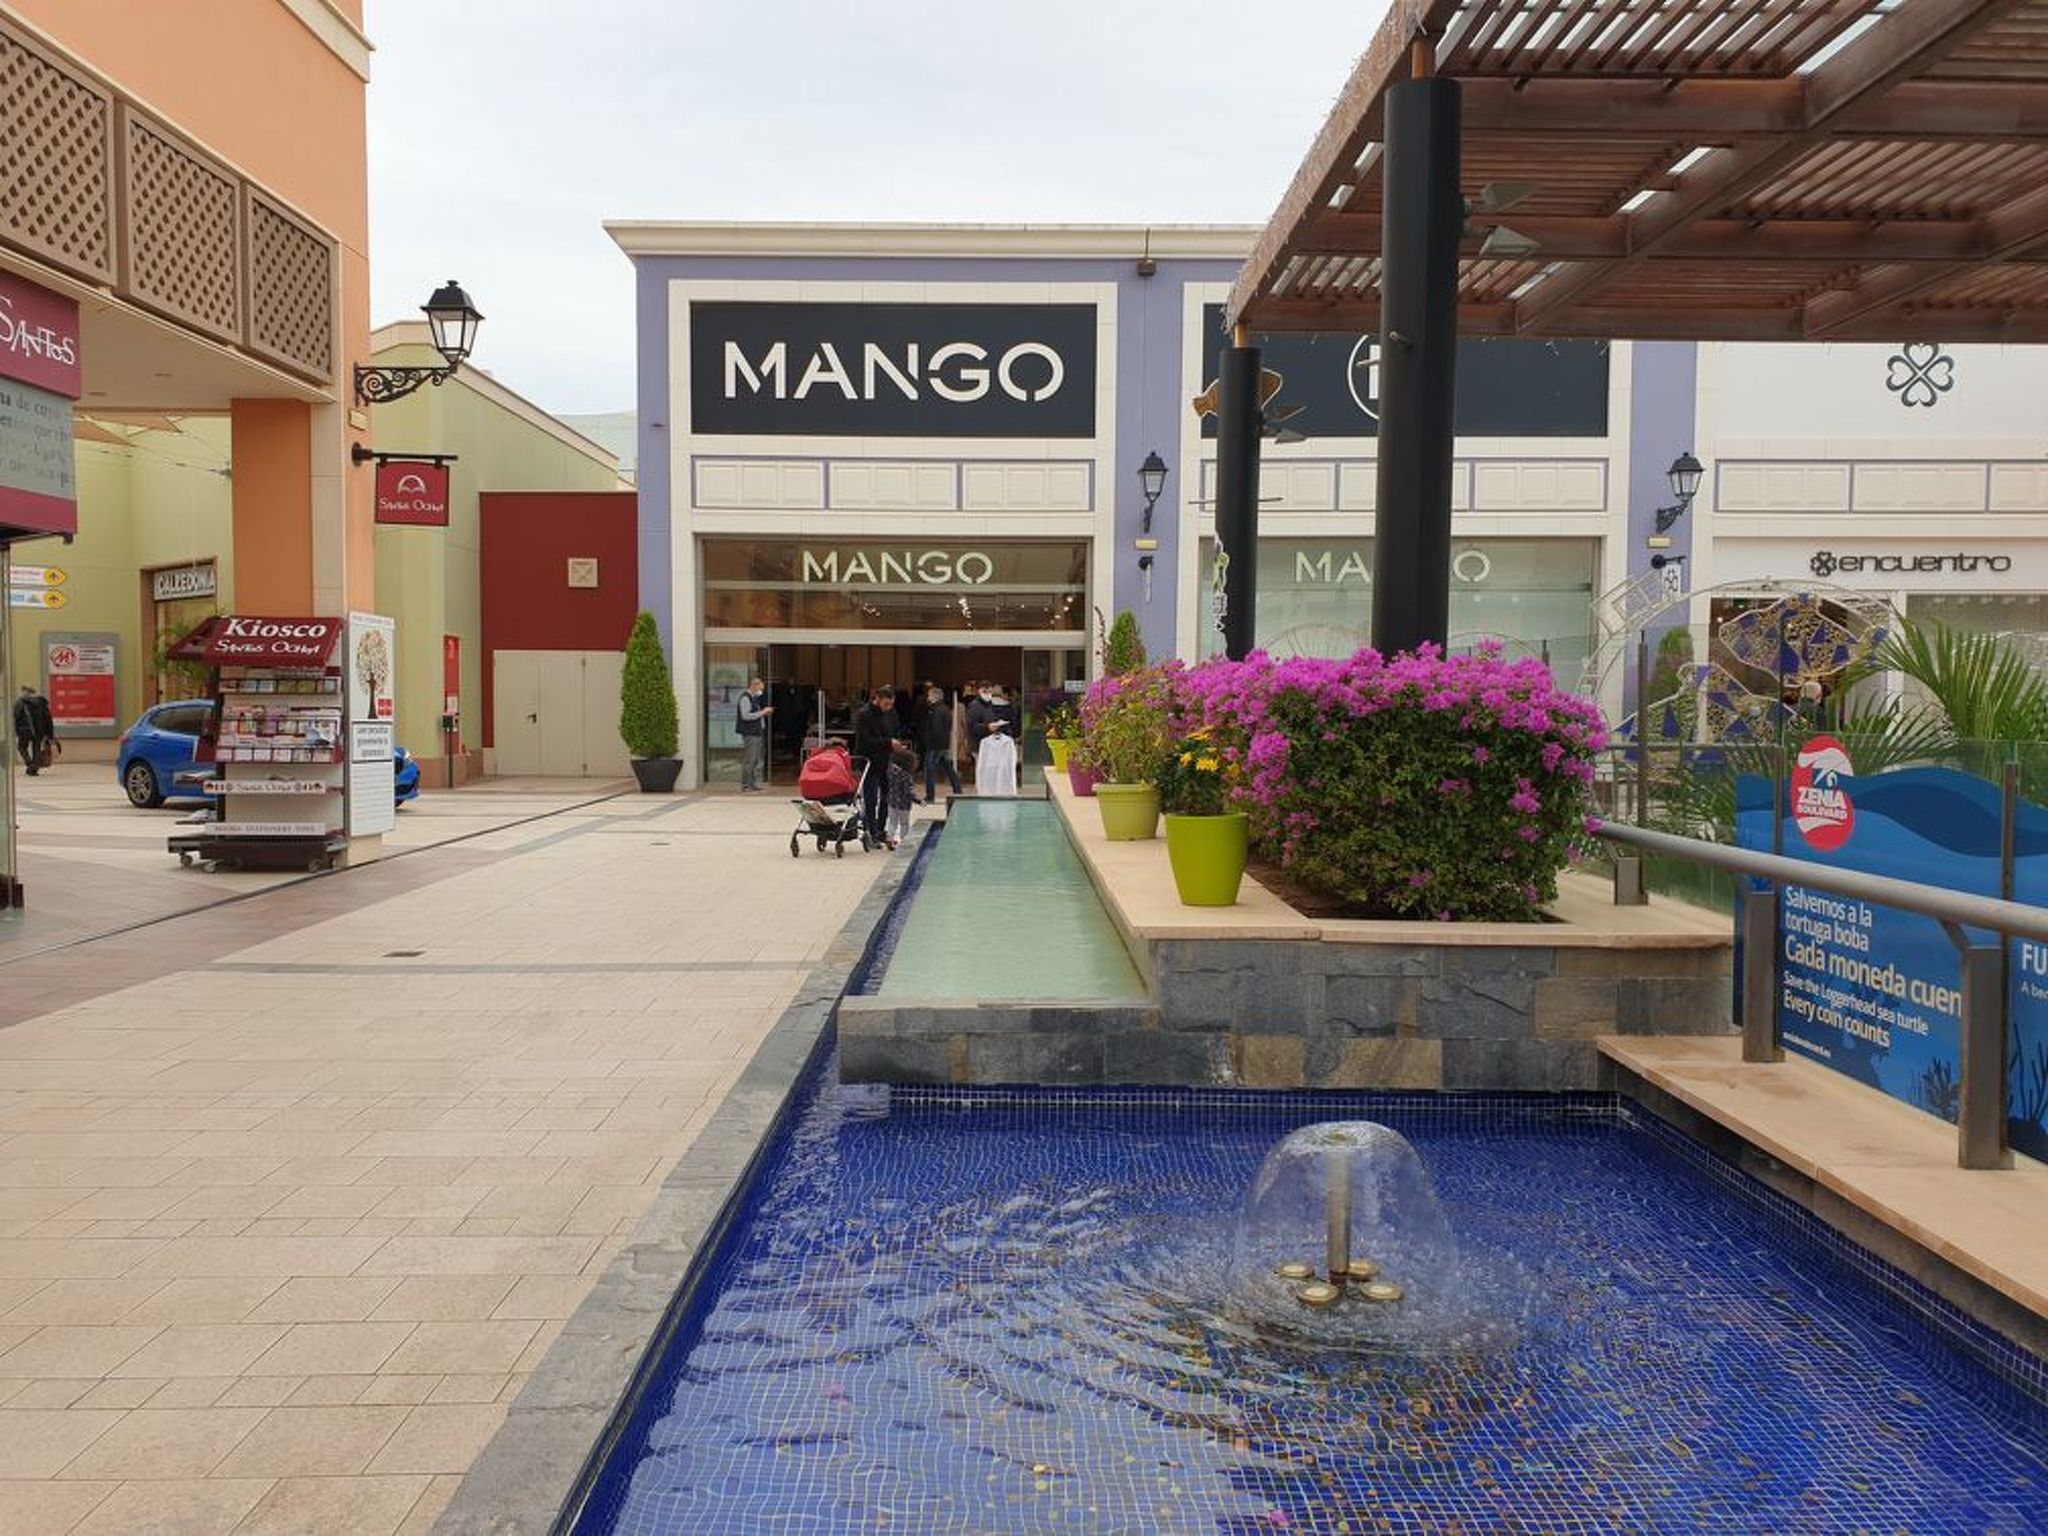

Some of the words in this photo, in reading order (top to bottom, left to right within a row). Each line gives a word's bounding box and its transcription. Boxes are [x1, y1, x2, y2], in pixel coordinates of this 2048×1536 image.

[724, 341, 1064, 402] MANGO
[803, 551, 993, 584] MANGO
[1296, 551, 1491, 583] MAO
[1839, 553, 2012, 572] encuentro
[224, 618, 327, 637] Kiosco
[1798, 787, 1847, 809] ZENIA
[1785, 886, 1845, 921] Salvemos
[1848, 909, 1857, 923] a
[1859, 902, 1872, 927] la
[1785, 911, 1831, 944] tortuga
[1834, 921, 1869, 952] boba
[1785, 935, 1825, 971] Cada
[1829, 952, 1906, 999] moneda
[1911, 979, 1962, 1017] cuen
[2022, 943, 2047, 975] FU
[1783, 971, 1803, 988] Save
[1804, 978, 1820, 996] the
[1821, 984, 1876, 1017] Loggerhead
[1877, 1006, 1895, 1024] sea
[1897, 1011, 1929, 1036] turtle
[1783, 989, 1815, 1023] Every
[1817, 1006, 1843, 1029] coin
[1844, 1014, 1890, 1047] counts
